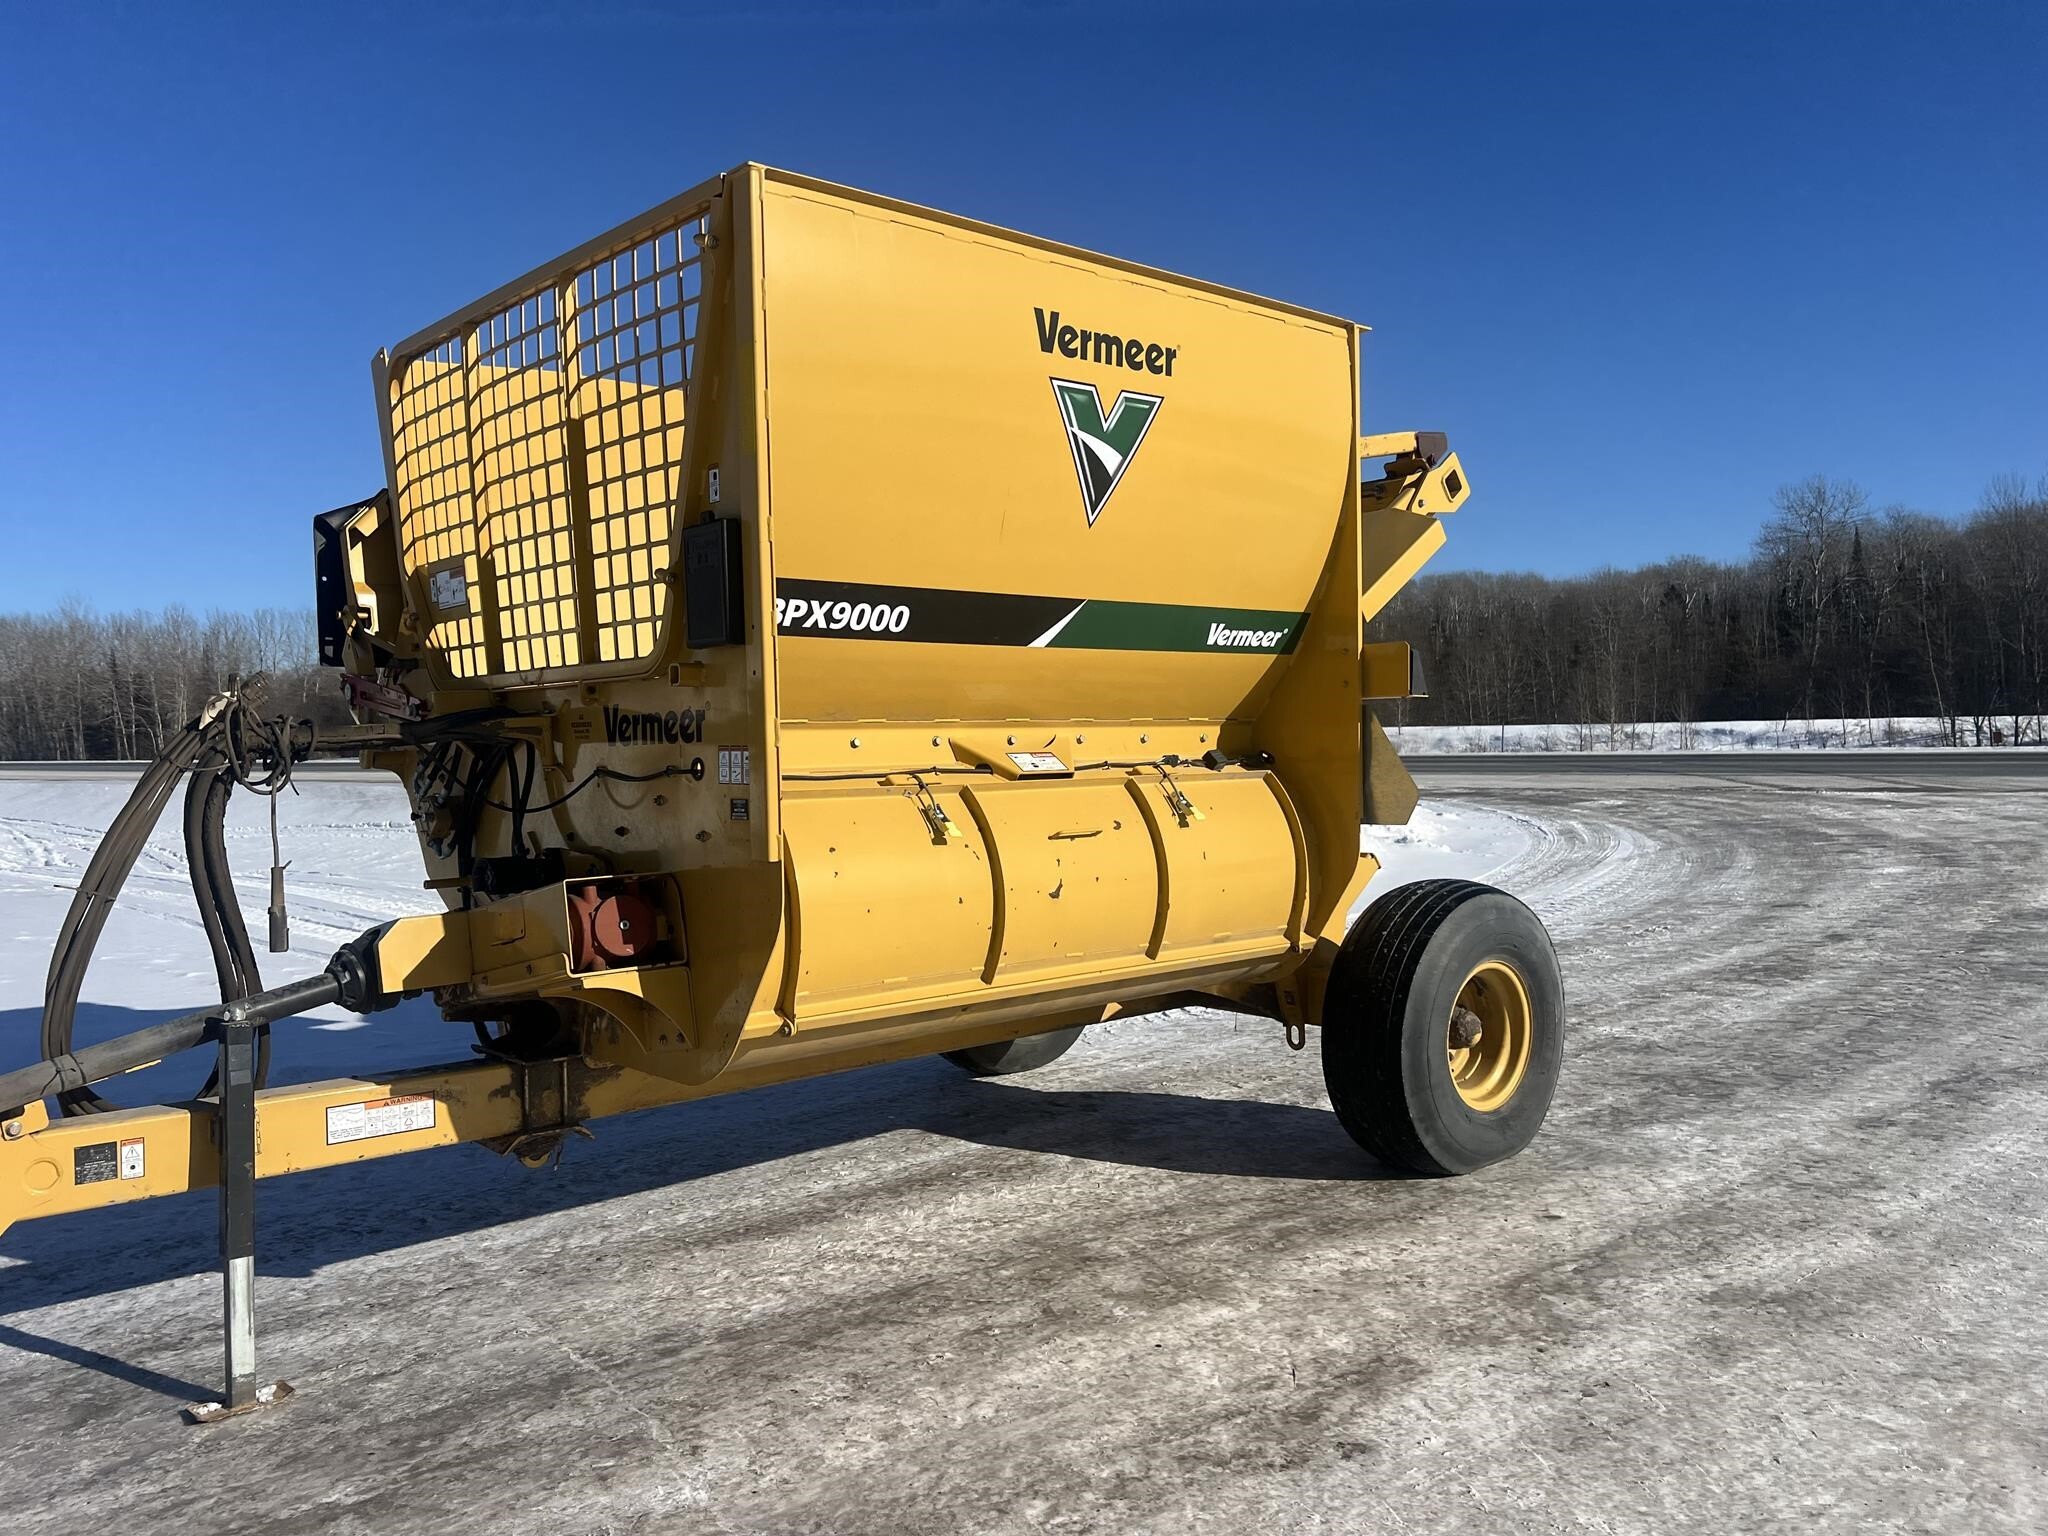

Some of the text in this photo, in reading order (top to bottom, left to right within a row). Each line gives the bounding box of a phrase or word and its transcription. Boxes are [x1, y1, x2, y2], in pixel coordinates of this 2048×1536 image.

[1033, 307, 1177, 377] Vermeer
[1206, 622, 1284, 648] Vermeer
[603, 703, 706, 747] Vermeer
[390, 1095, 423, 1106] WARNING
